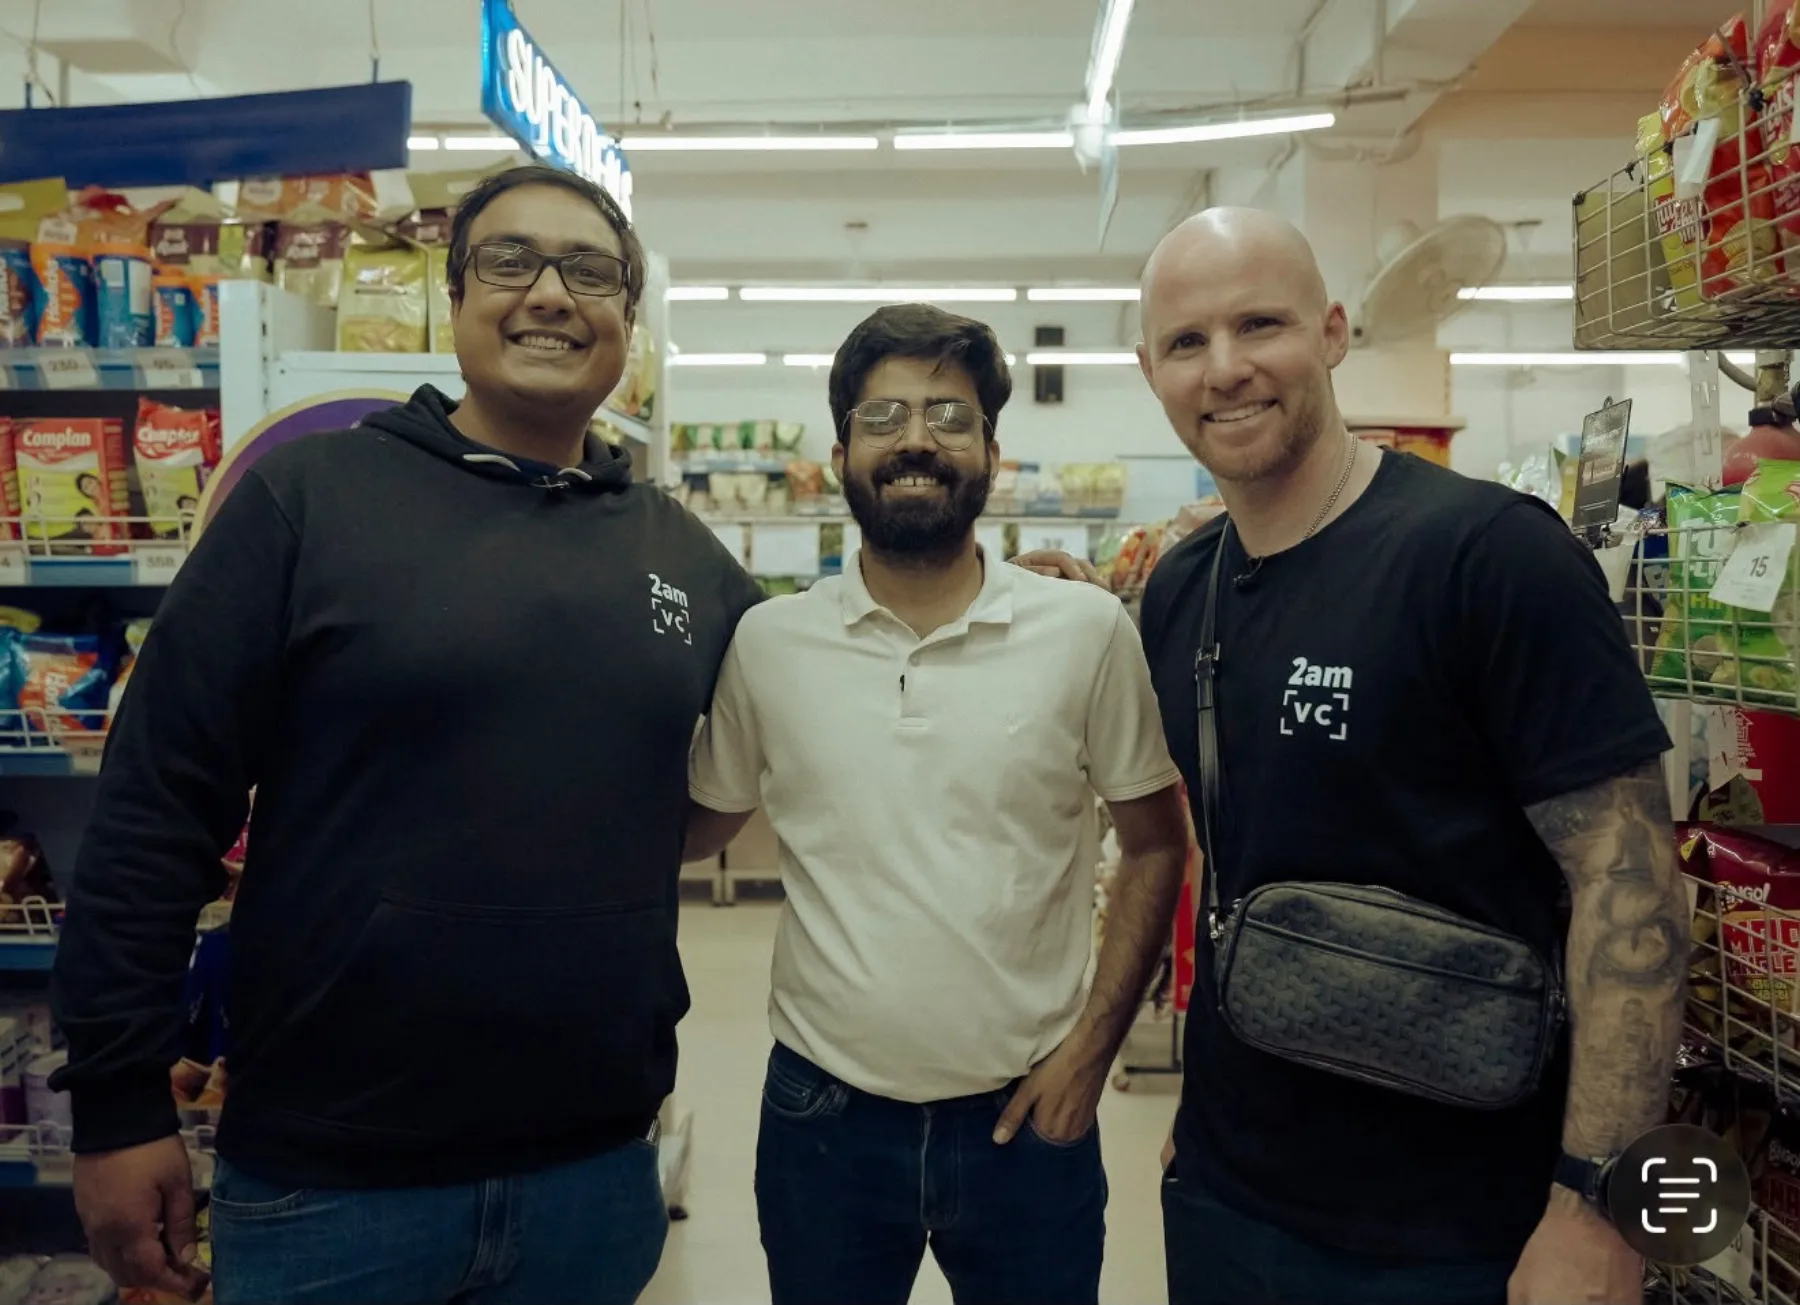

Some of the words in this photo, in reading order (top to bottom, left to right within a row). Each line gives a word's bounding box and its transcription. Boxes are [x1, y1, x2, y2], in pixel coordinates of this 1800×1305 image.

[23, 426, 92, 449] Complan
[1750, 556, 1770, 578] 15
[648, 573, 689, 608] 2am
[1288, 656, 1353, 689] 2am
